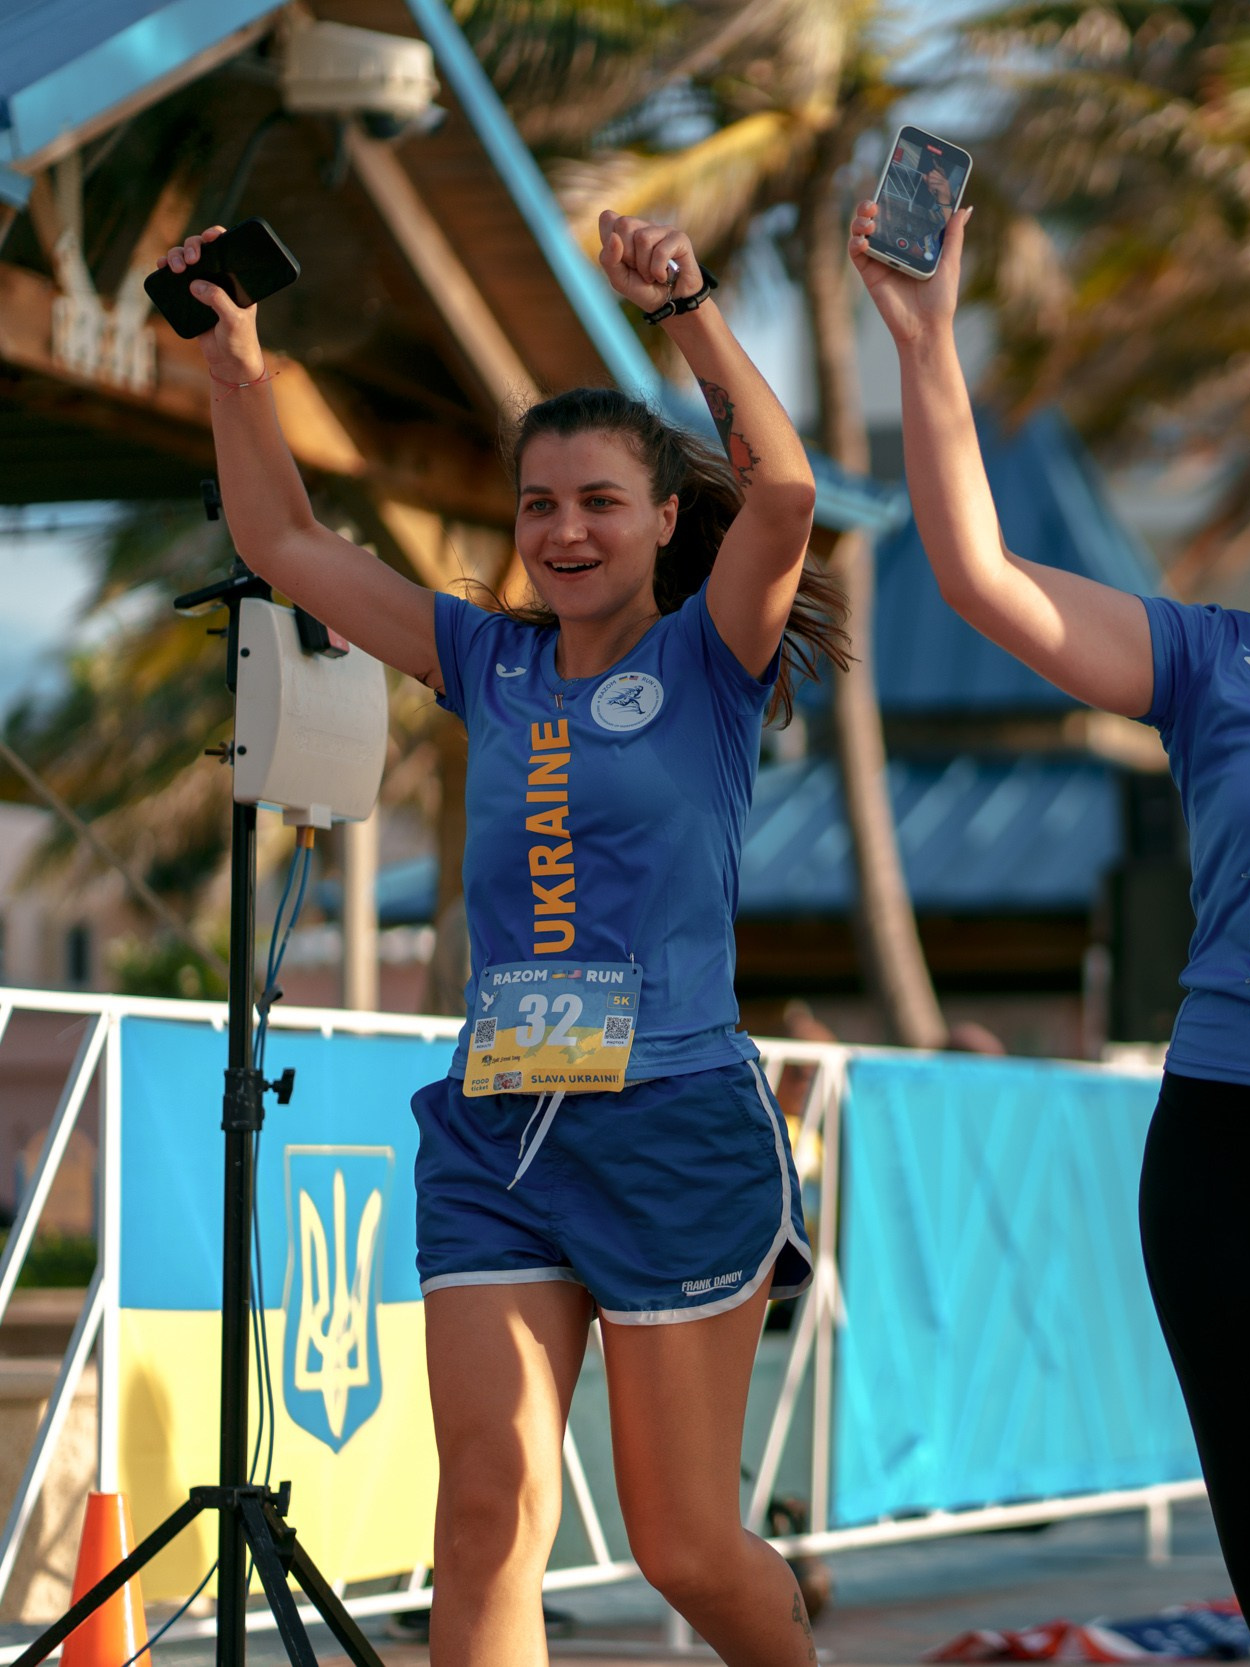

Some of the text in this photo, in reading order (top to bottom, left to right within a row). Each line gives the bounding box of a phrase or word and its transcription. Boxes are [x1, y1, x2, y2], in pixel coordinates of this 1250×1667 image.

[641, 676, 655, 686] RUN
[526, 718, 576, 955] UKRAINE
[493, 969, 623, 986] RAZOM RUN
[612, 996, 630, 1006] 5K
[515, 993, 583, 1048] 32
[471, 1078, 490, 1086] FOOD
[531, 1074, 620, 1084] SLAVA UKRAINI!
[682, 1270, 743, 1292] FRANK DANDY
